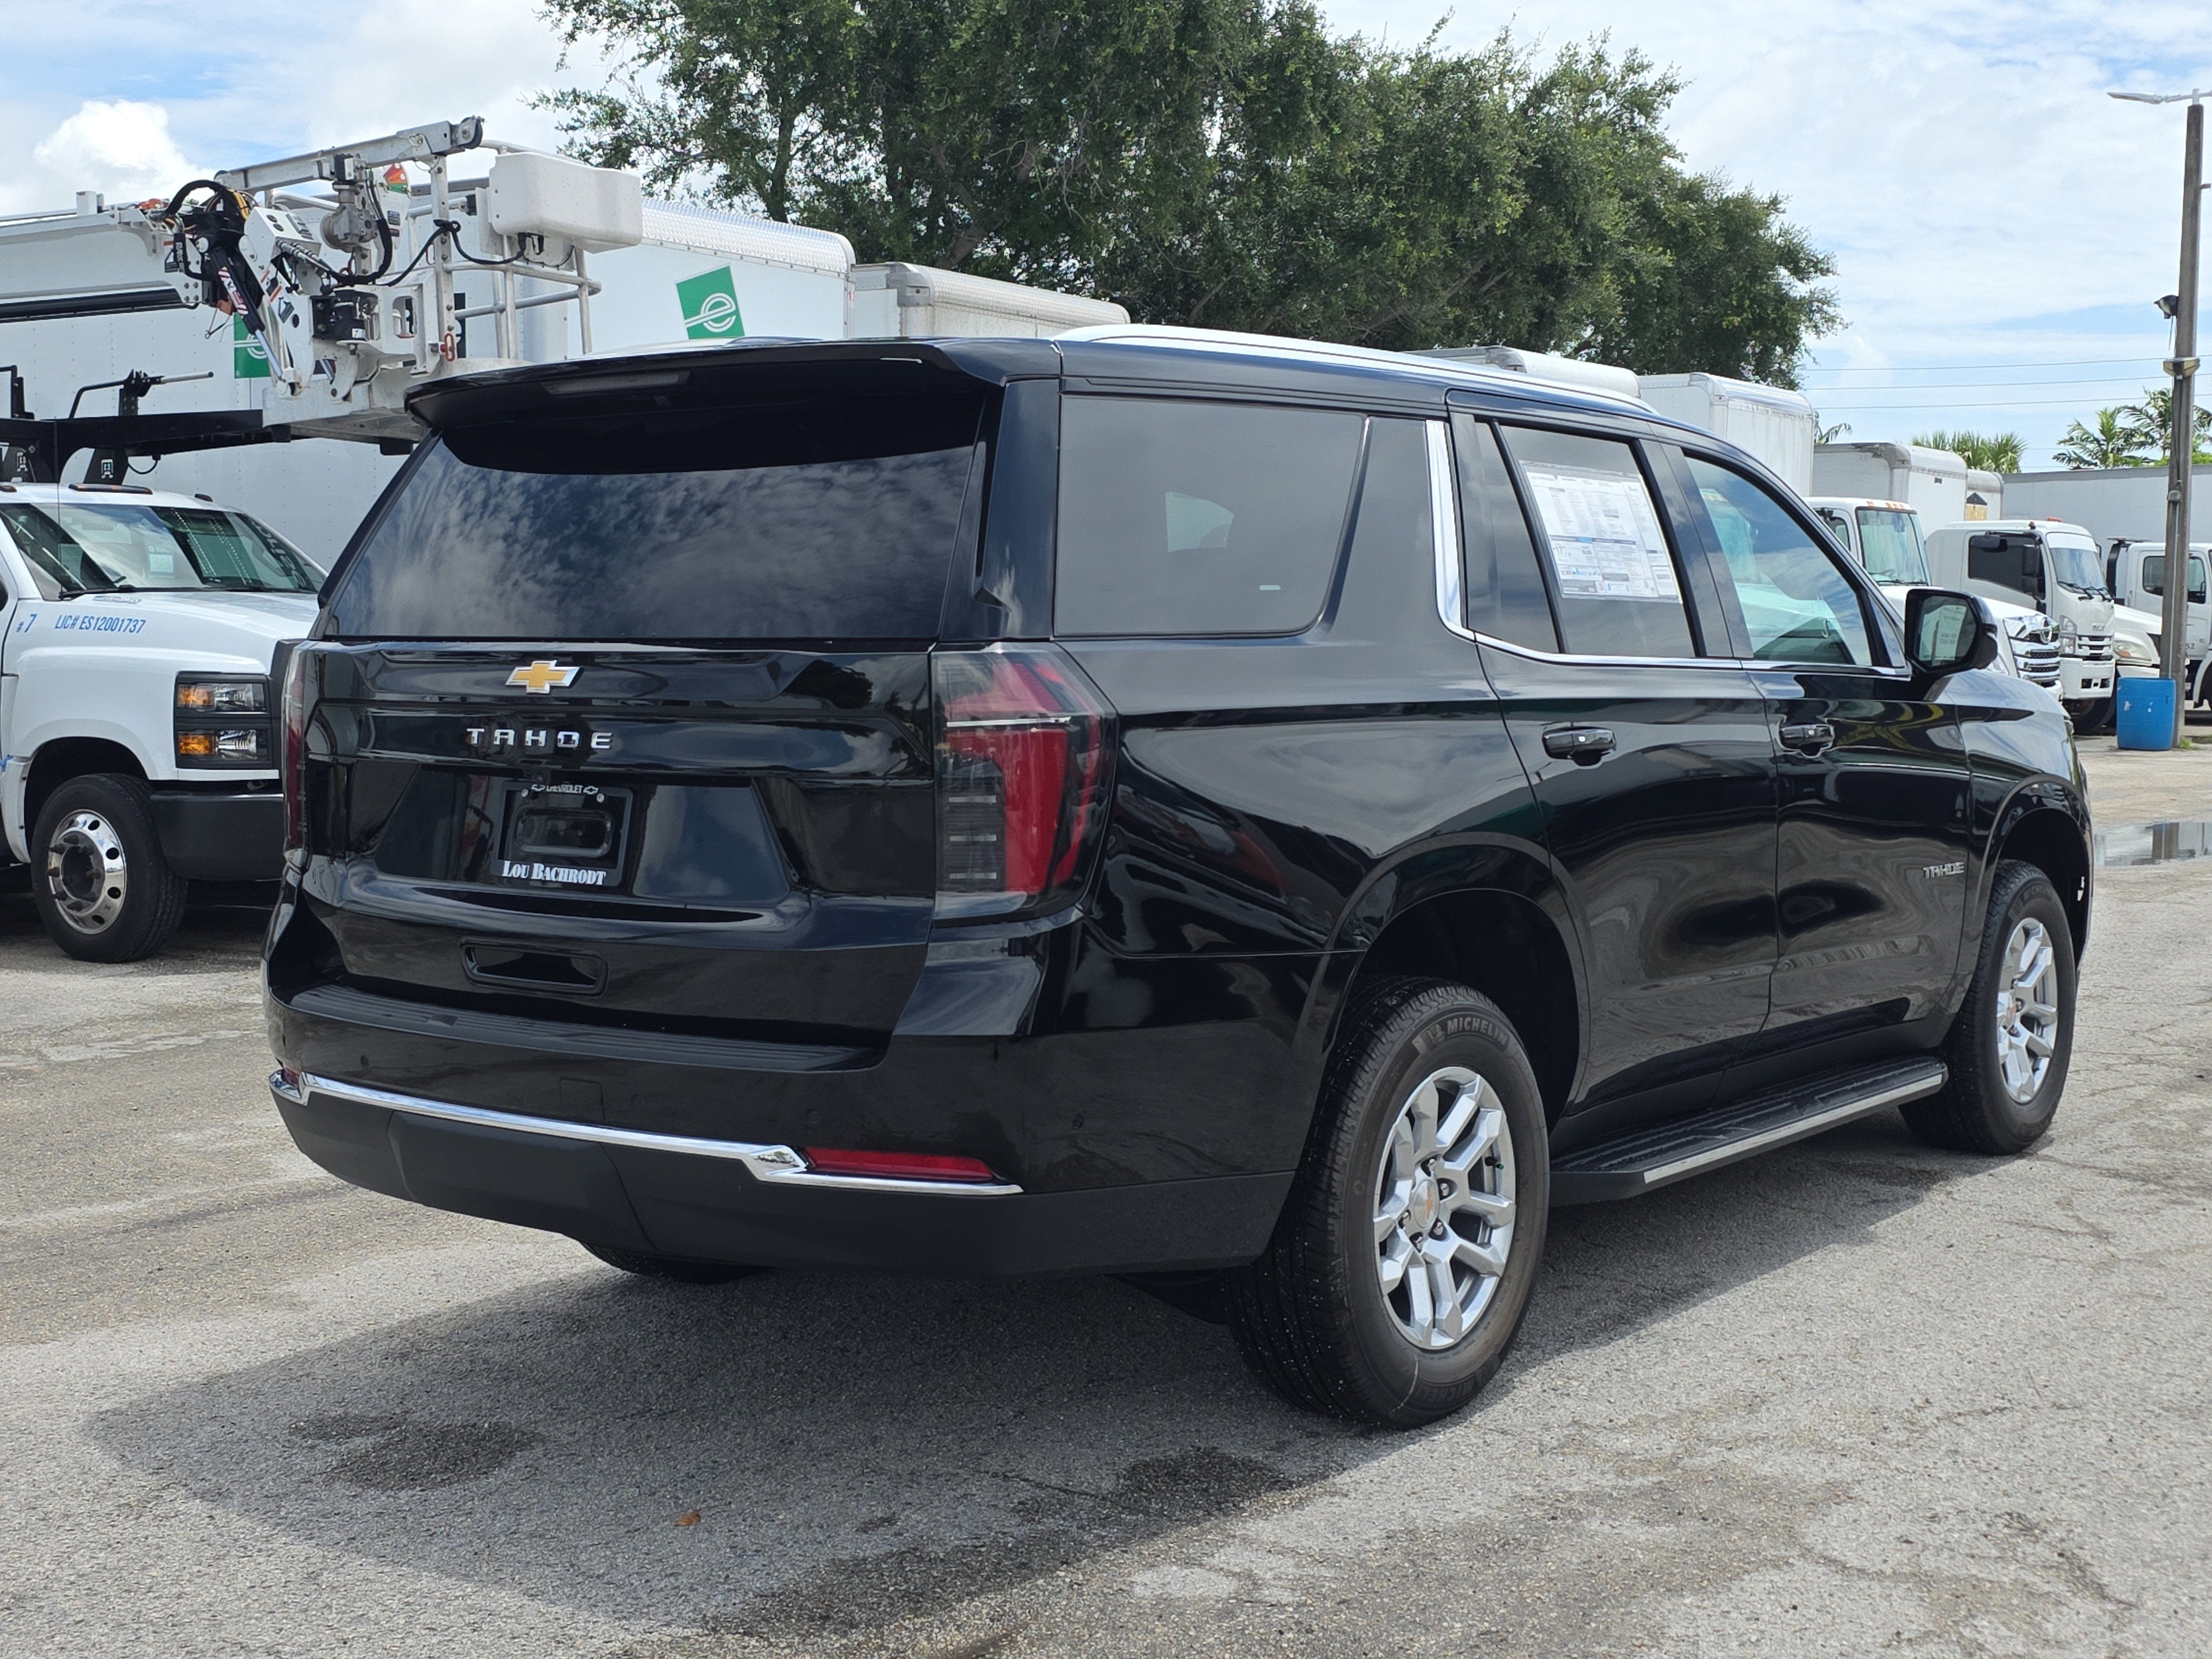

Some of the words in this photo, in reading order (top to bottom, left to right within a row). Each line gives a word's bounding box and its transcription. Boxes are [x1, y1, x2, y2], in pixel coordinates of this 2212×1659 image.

[55, 614, 80, 630] LIC#
[79, 616, 147, 634] ES12001737
[466, 728, 613, 749] TAHOE
[530, 863, 607, 886] BACHRODT
[1922, 861, 1965, 879] TAHOE
[1446, 1017, 1510, 1046] MICHELIN
